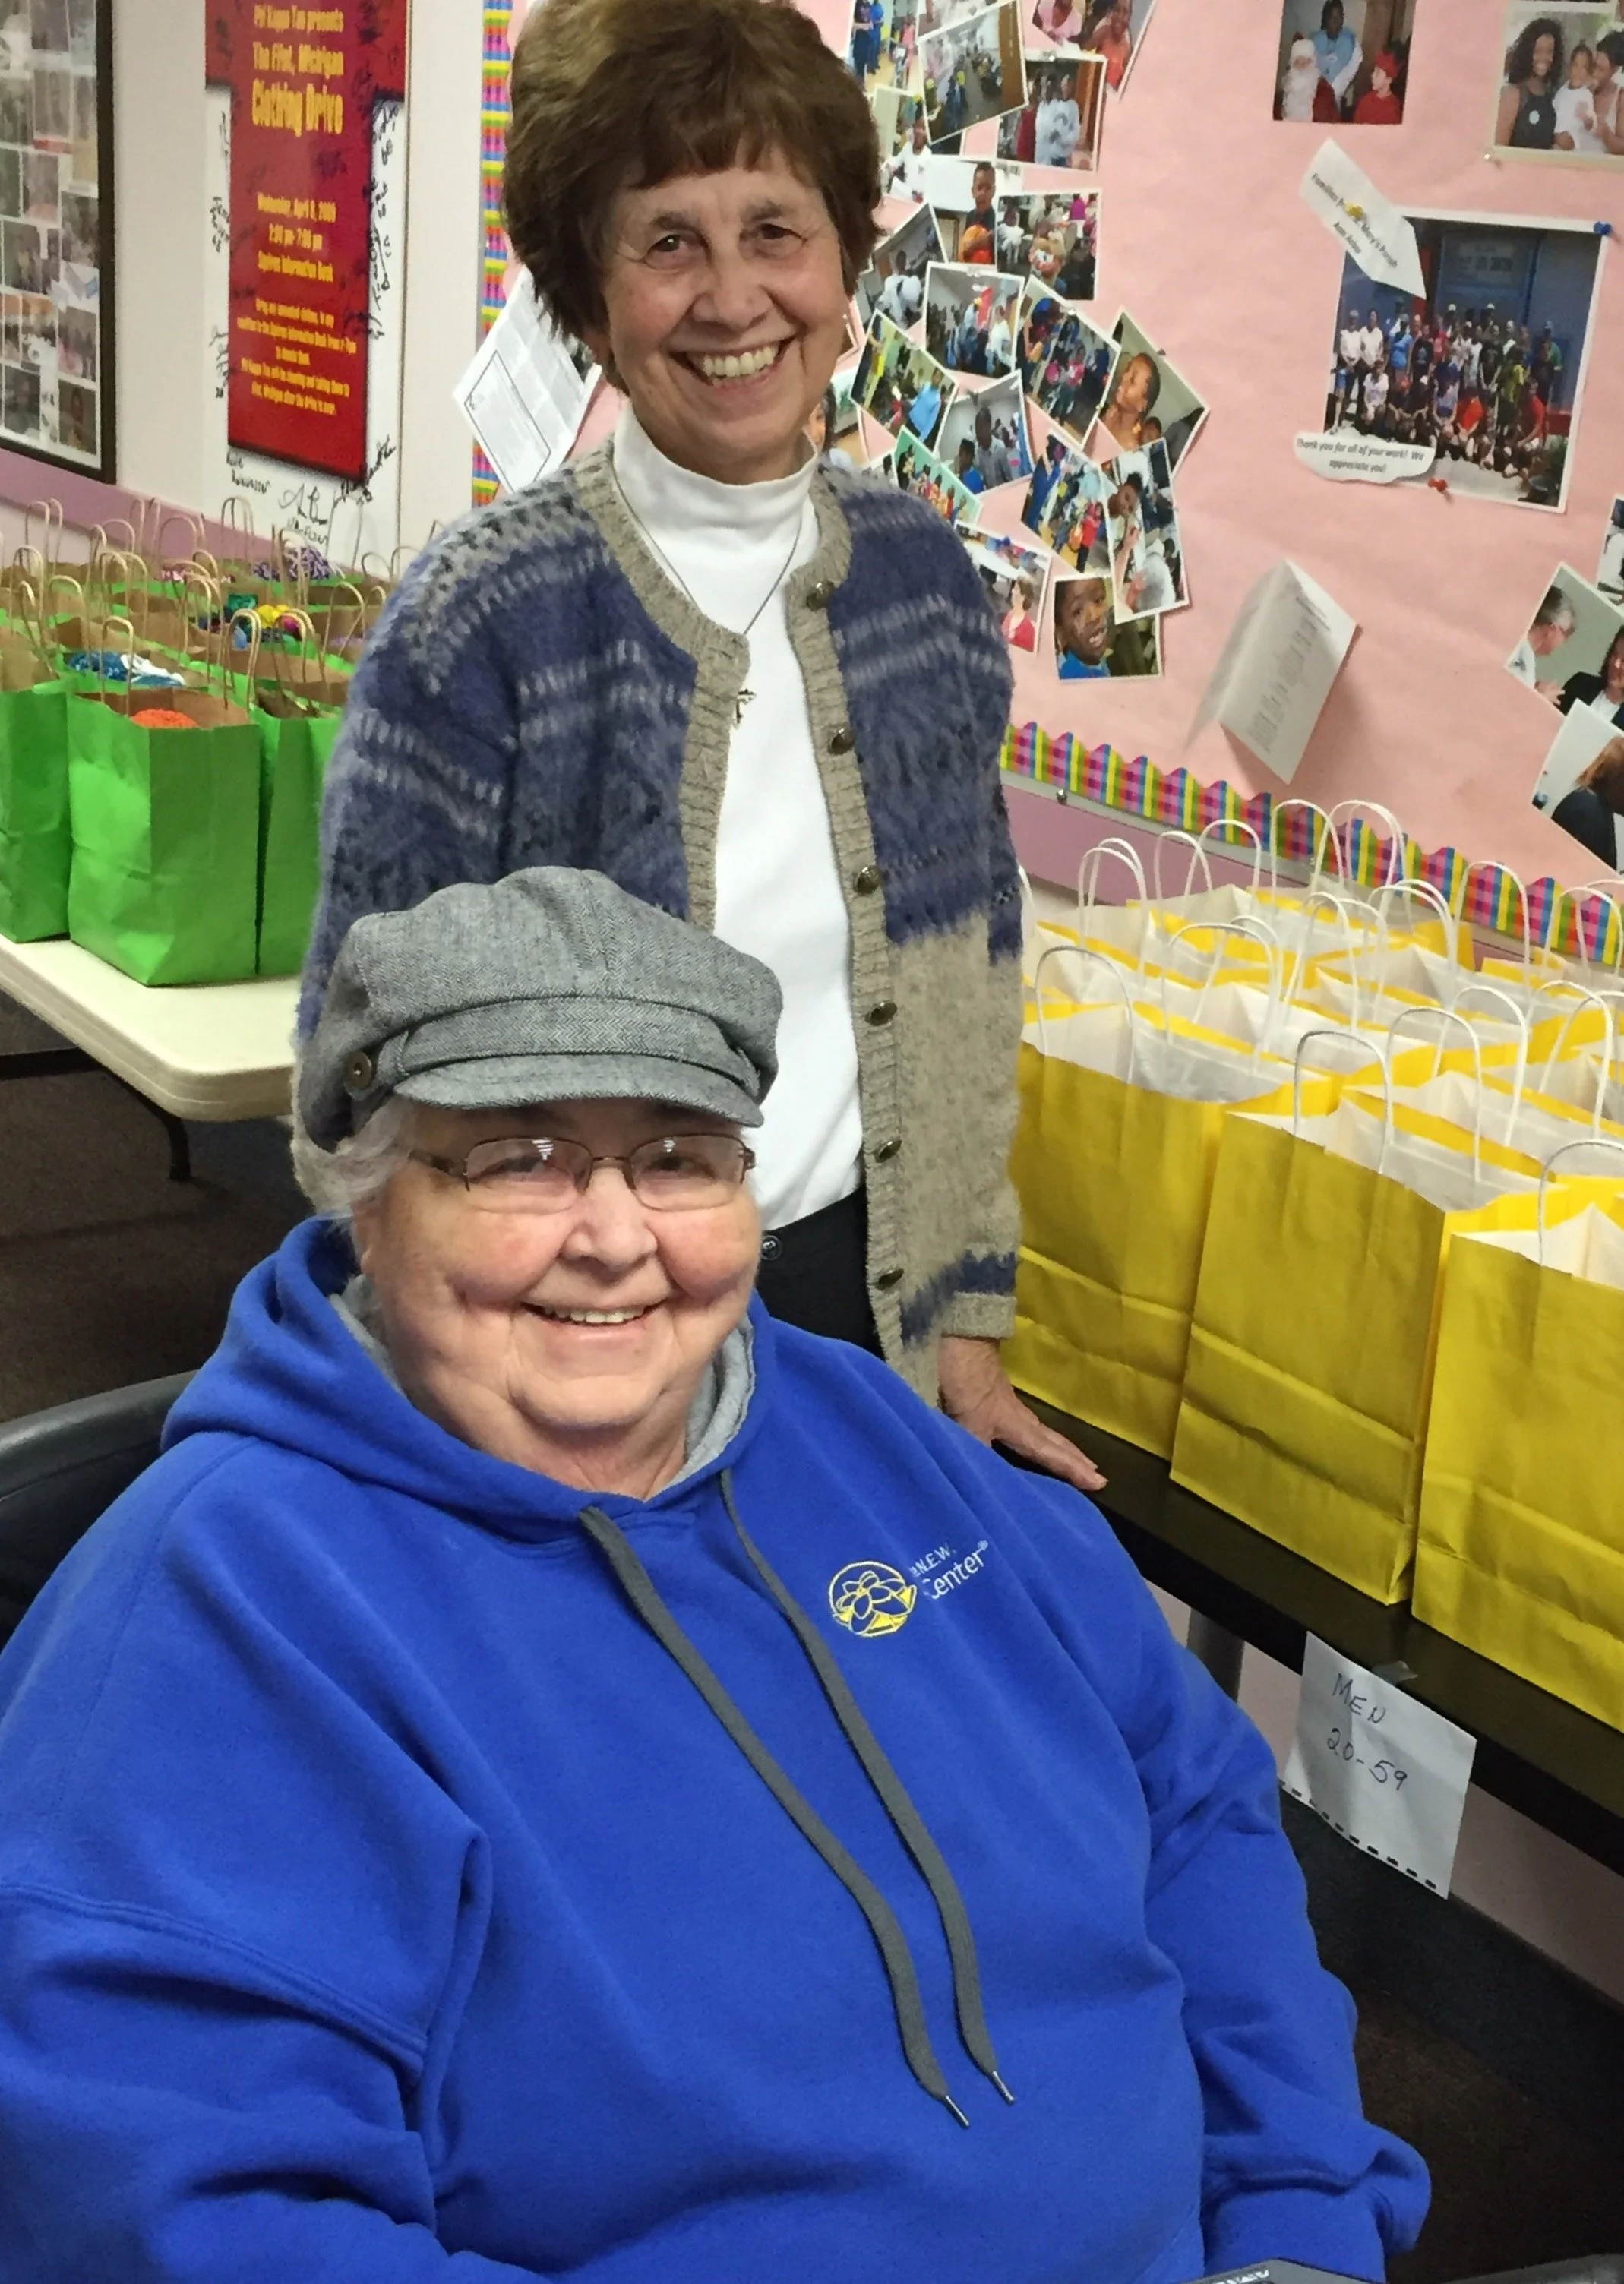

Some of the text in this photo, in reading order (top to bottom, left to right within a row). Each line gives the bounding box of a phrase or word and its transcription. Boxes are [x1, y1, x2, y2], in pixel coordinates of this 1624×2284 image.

[1319, 443, 1334, 452] you
[1334, 442, 1347, 453] for
[1348, 444, 1357, 453] all
[1358, 445, 1368, 456] of
[1368, 447, 1385, 456] your
[1332, 1673, 1386, 1724] MEN
[1326, 1727, 1408, 1791] 20-59
